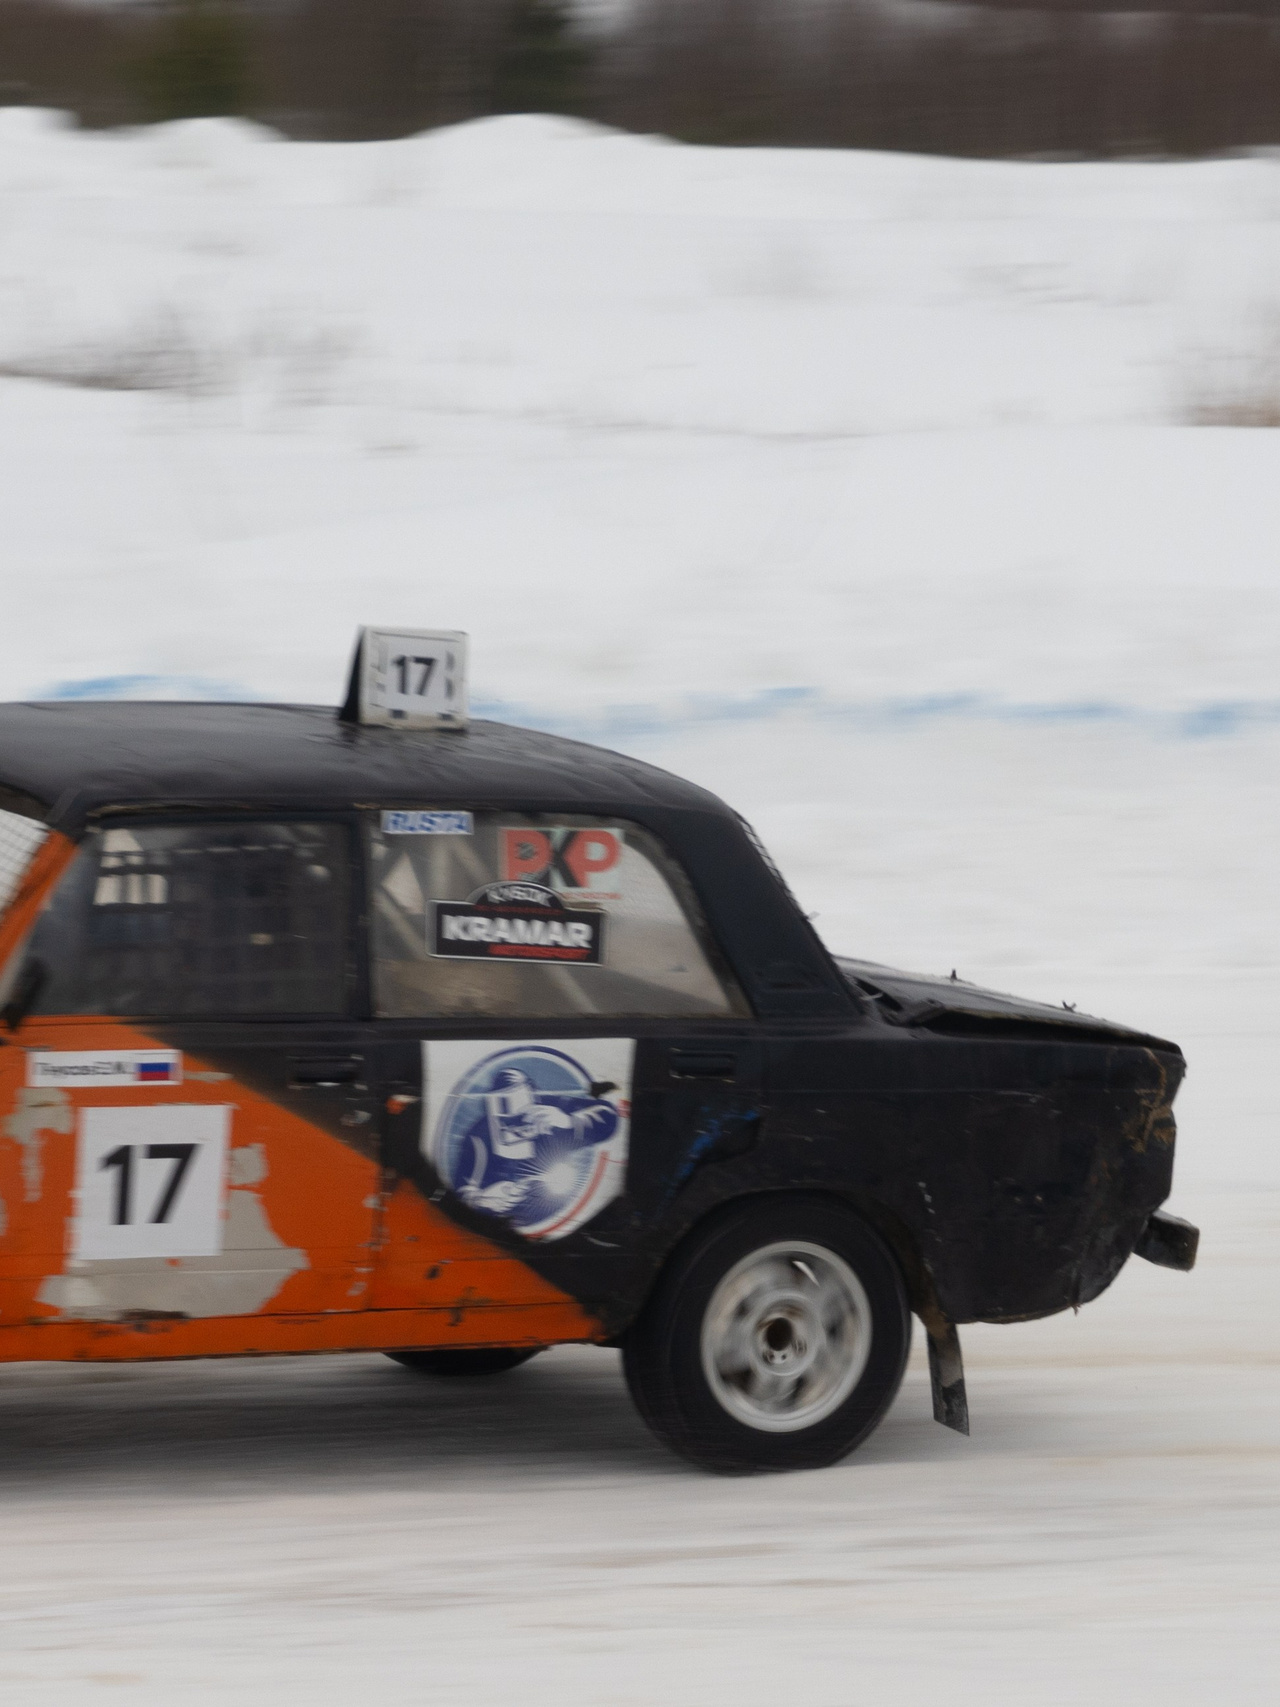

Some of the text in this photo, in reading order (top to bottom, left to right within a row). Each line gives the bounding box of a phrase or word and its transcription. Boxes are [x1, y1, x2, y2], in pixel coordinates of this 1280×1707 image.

[391, 655, 440, 697] 17
[441, 914, 594, 949] KRAMAR
[96, 1142, 204, 1226] 17
